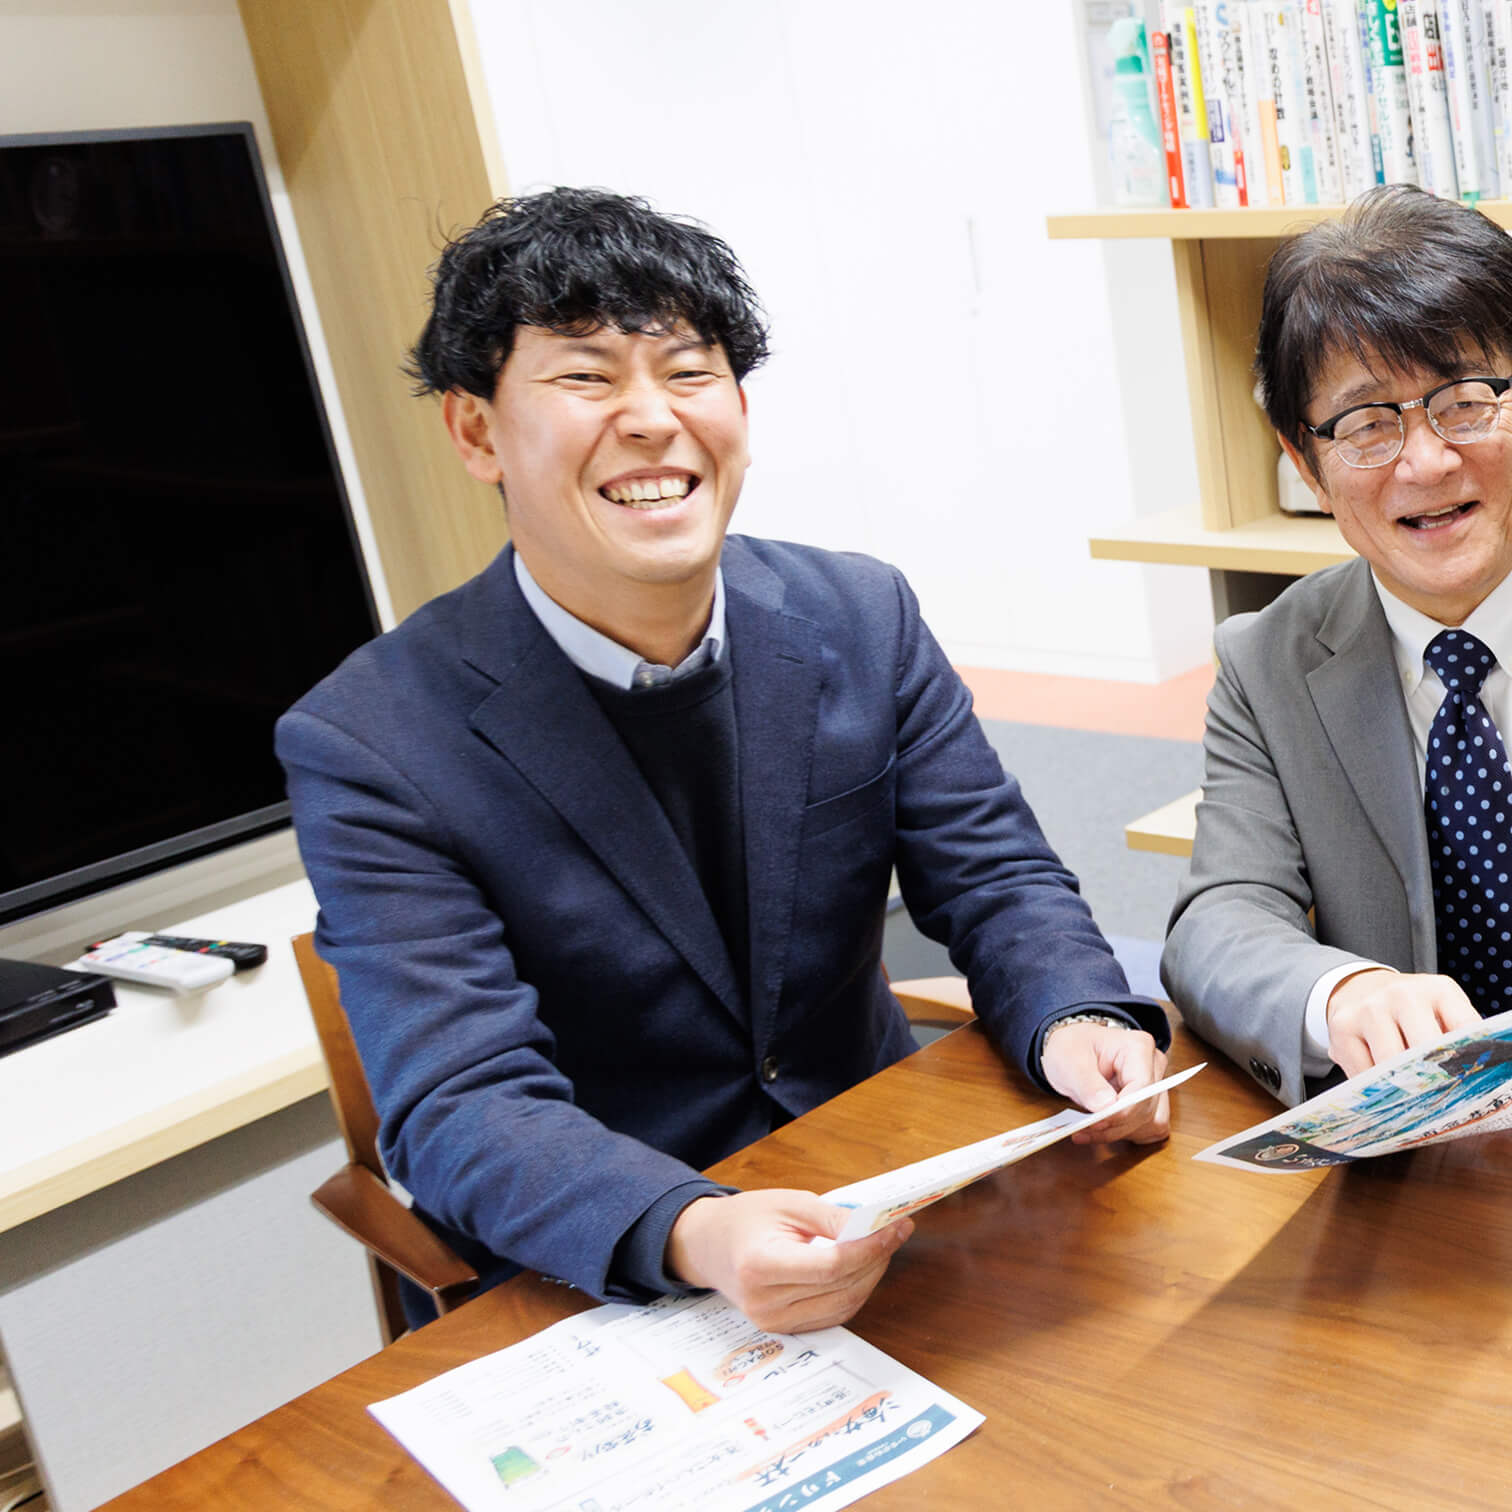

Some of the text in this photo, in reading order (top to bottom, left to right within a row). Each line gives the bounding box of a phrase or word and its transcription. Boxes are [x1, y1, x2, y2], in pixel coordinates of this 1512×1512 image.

[721, 1342, 786, 1379] SORACHI
[762, 1347, 822, 1383] ビール
